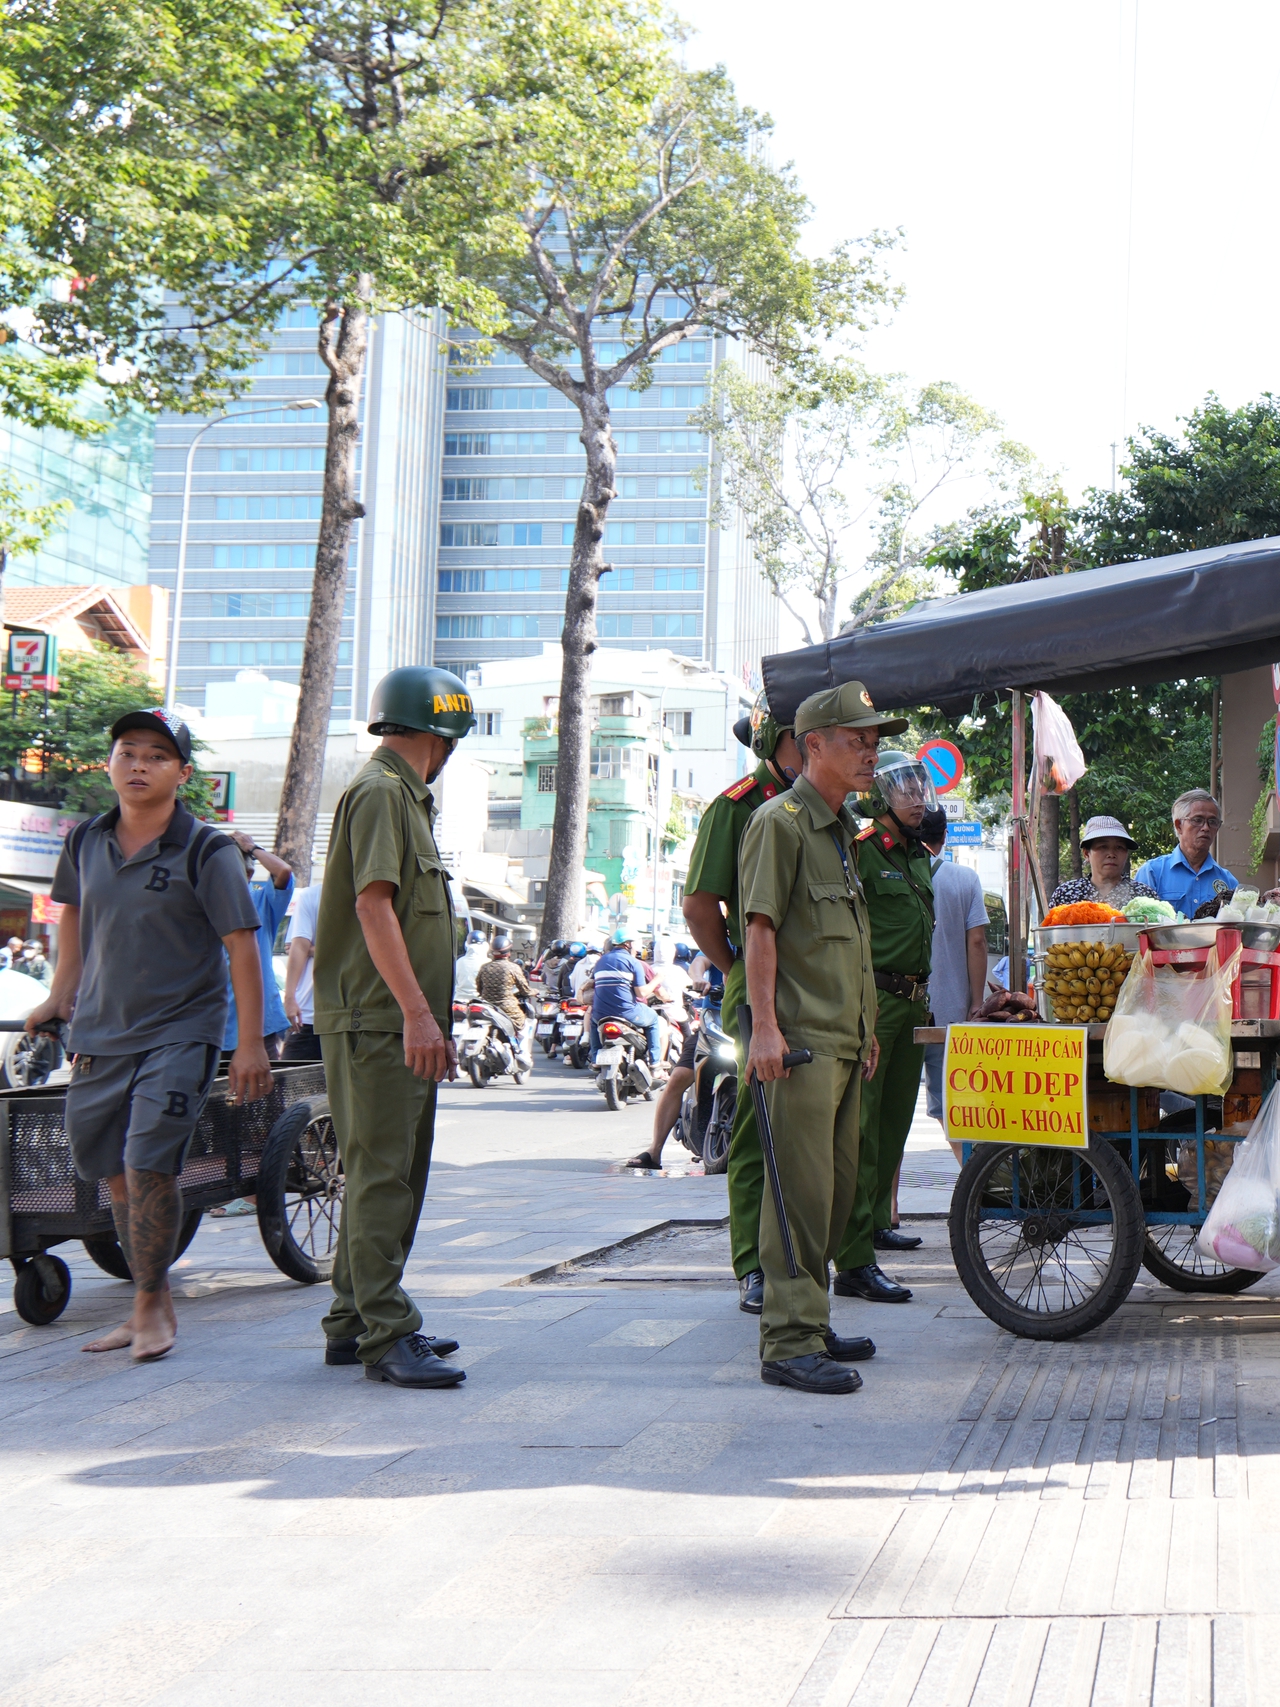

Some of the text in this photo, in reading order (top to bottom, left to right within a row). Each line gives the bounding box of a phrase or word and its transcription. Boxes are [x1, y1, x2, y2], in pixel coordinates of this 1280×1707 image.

[144, 865, 171, 893] B
[950, 1032, 1083, 1062] XÔI NGỌT THẬP CẨM
[949, 1062, 1080, 1103] CỐM DẸP
[162, 1090, 189, 1118] B
[949, 1101, 1007, 1130] CHUỐI
[1021, 1109, 1083, 1134] KHOAI
